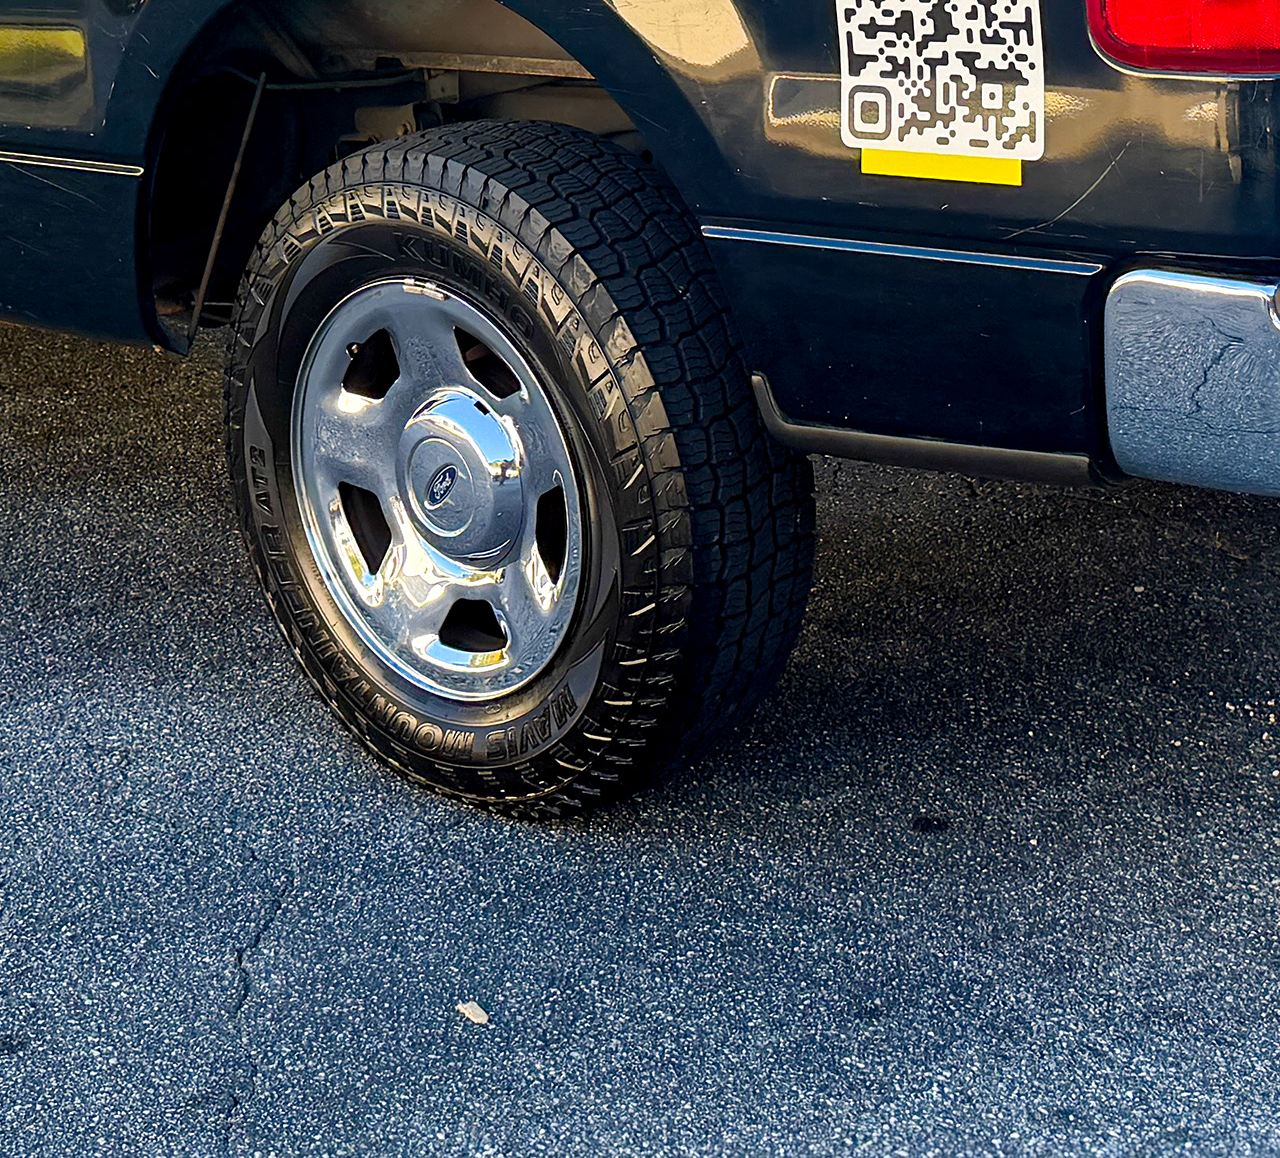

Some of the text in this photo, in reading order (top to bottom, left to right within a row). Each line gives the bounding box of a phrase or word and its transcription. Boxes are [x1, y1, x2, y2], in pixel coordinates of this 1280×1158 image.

[391, 231, 535, 340] KUMHO
[249, 445, 579, 761] MAVIS MOUNTAINEER AT2
